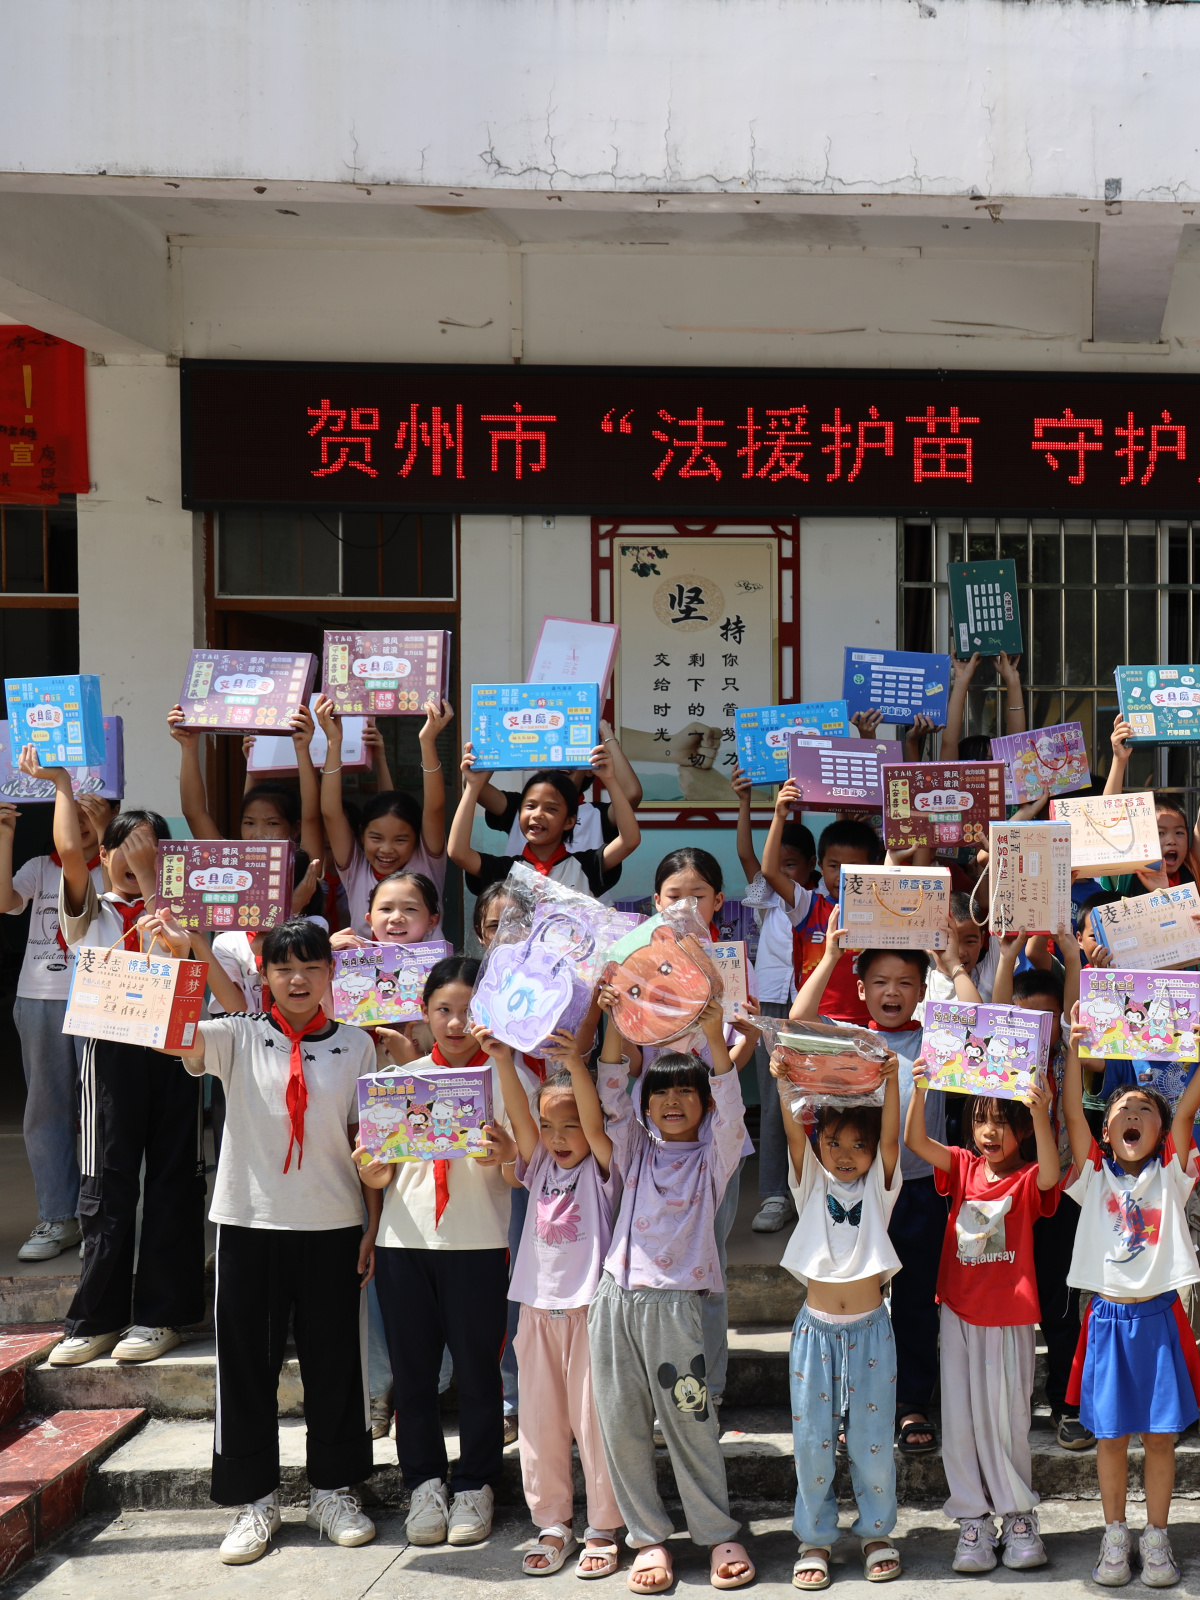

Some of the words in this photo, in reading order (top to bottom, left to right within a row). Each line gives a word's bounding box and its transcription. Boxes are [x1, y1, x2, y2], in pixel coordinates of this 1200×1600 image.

[687, 653, 705, 767] 剩下的一切
[721, 653, 740, 766] 你只管努力
[1103, 797, 1146, 809] 惊喜盲盒
[898, 879, 944, 890] 惊喜盲盒
[925, 892, 945, 901] 万里
[1149, 888, 1192, 908] 惊喜盲盒
[1178, 899, 1199, 911] 万里
[128, 959, 172, 977] 惊喜盲盒
[719, 959, 741, 969] 万里
[152, 978, 172, 989] 万里
